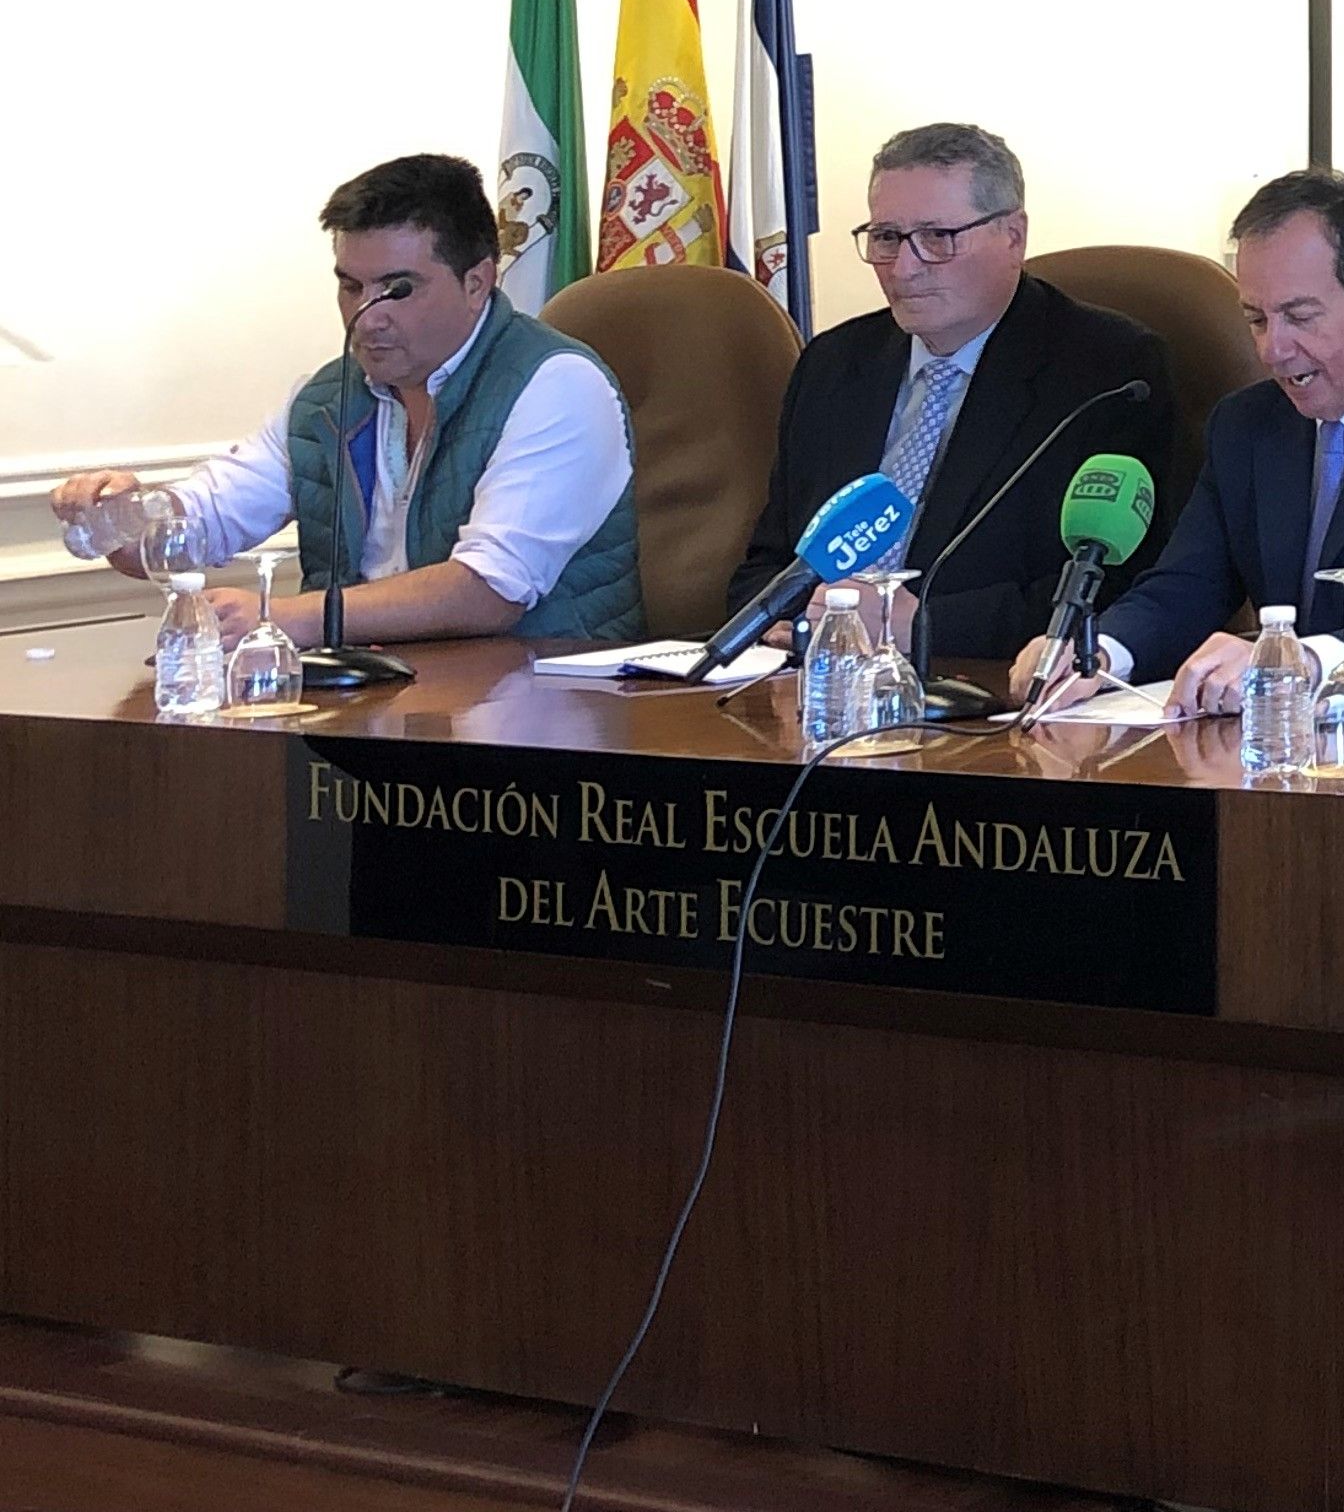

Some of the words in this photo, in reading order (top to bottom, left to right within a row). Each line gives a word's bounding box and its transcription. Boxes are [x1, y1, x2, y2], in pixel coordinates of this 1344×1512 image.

[827, 504, 900, 570] Jerez
[843, 521, 869, 541] Tele
[308, 761, 560, 839] FUNDACIÓN
[577, 780, 687, 849] REAL
[703, 790, 900, 864] ESCUELA
[909, 801, 1186, 882] ANDALUZA
[498, 876, 574, 927] DEL
[584, 868, 699, 939] ARTE
[716, 878, 945, 959] ECUESTRE
